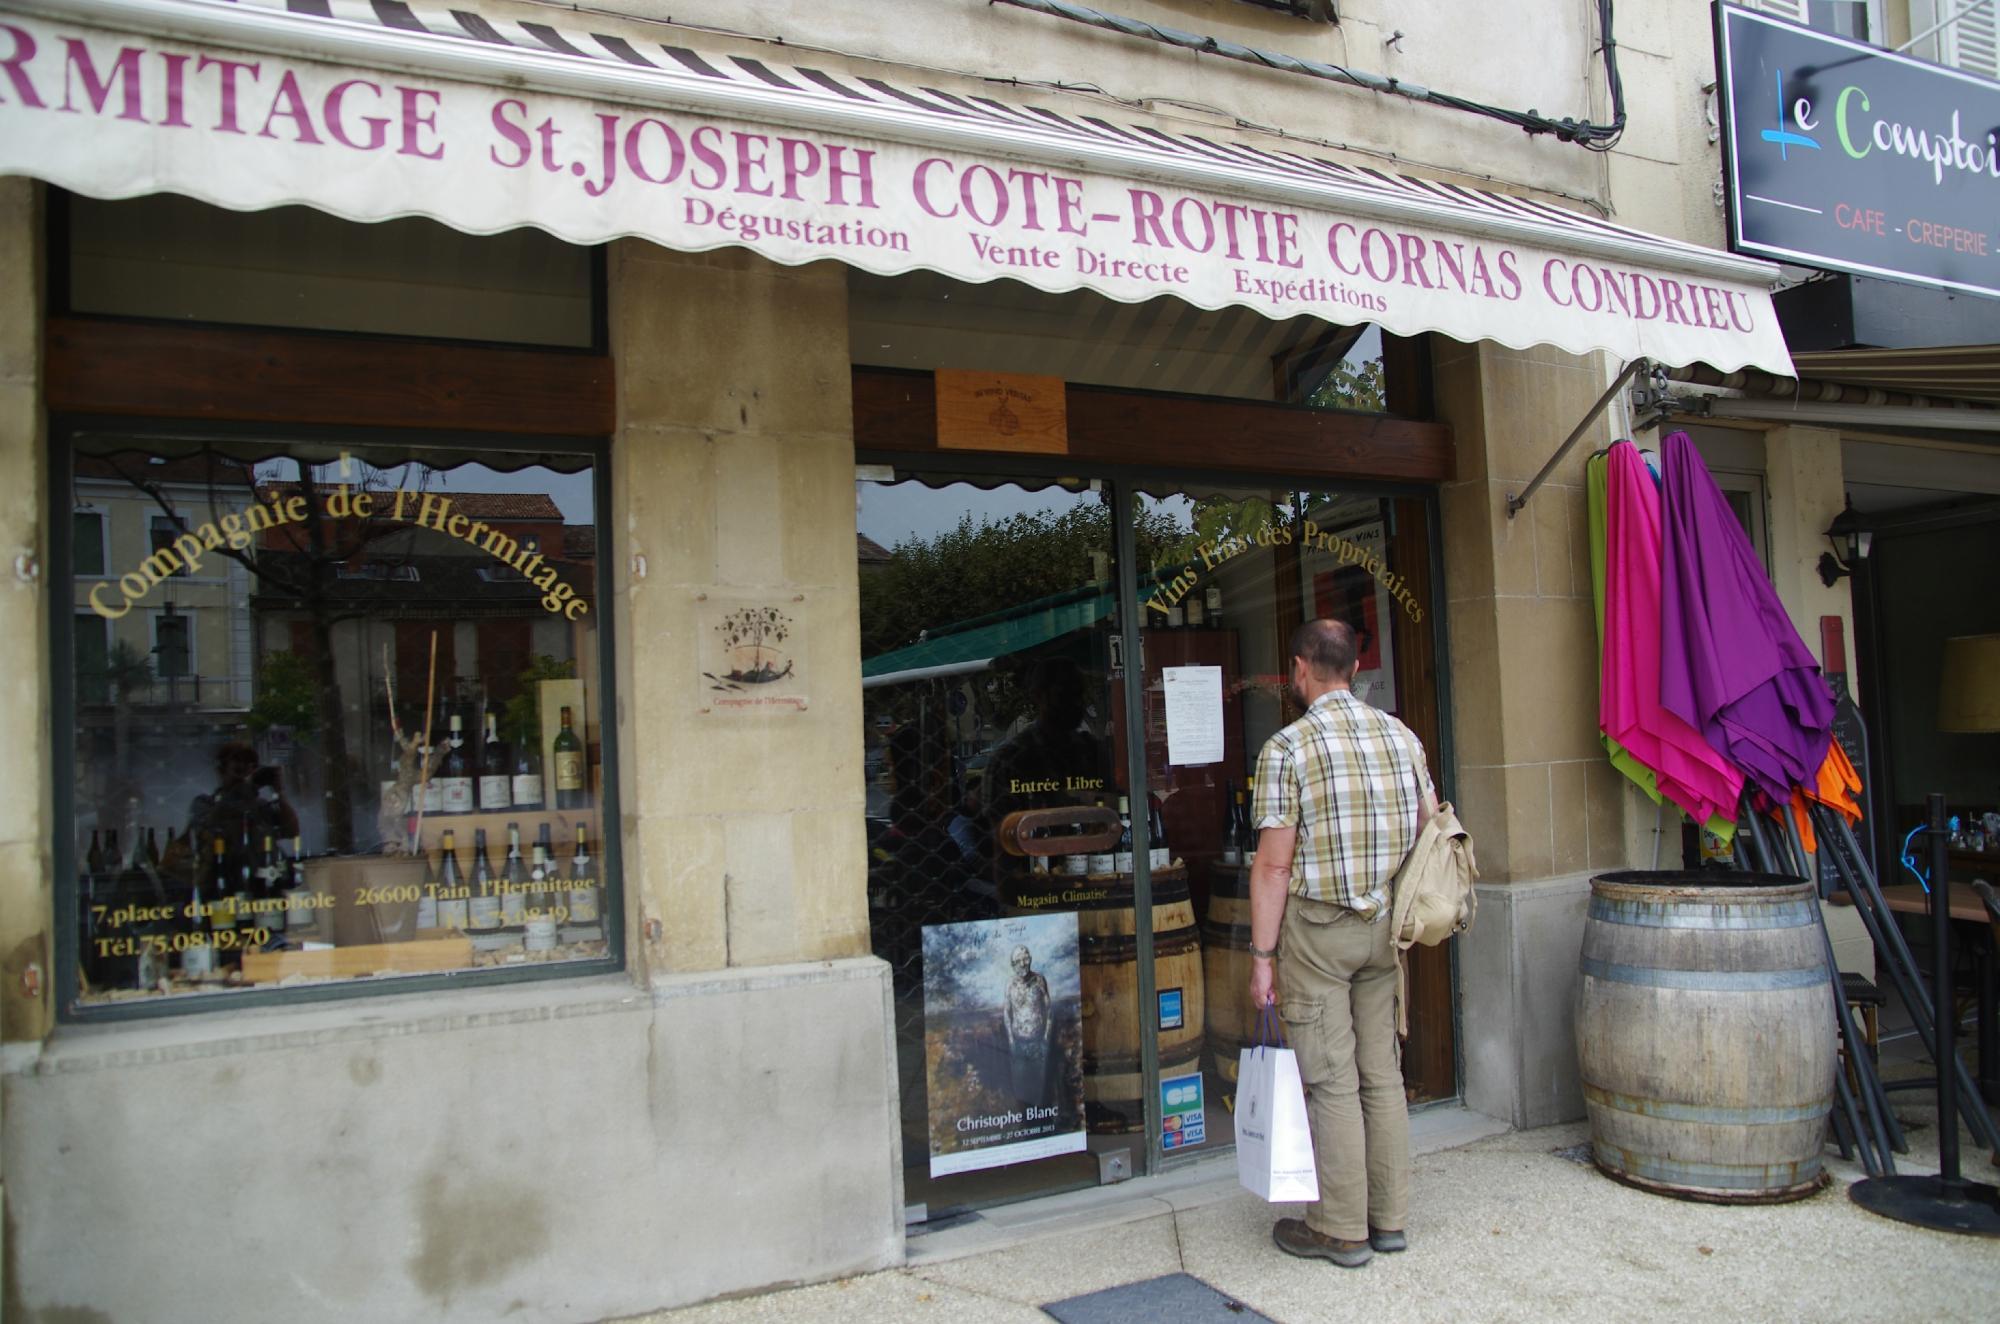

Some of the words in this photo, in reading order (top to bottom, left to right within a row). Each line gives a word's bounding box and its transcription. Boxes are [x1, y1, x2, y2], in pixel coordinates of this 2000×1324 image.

[1761, 69, 1821, 162] Le
[1835, 203, 1886, 238] CAFE
[1907, 219, 1988, 256] CREPERIE
[684, 197, 911, 252] Dégustation
[969, 233, 1061, 269] Vente
[1077, 246, 1189, 284] Directe
[1233, 268, 1388, 313] Expéditions
[1327, 222, 1522, 301] CORNAS
[1543, 258, 1755, 333] CONDRIEU
[88, 490, 308, 620] Compagnie
[327, 484, 373, 518] de
[391, 488, 588, 621] l'Hermitage
[1146, 566, 1198, 615] Vins
[1197, 534, 1248, 571] Fins
[1256, 524, 1292, 547] des
[1303, 520, 1425, 625] Propriétaires
[1010, 778, 1060, 794] Entrée
[1066, 776, 1104, 790] Libre
[183, 900, 213, 918] du
[221, 891, 336, 914] Taurobole
[354, 884, 420, 905] 26600
[424, 882, 471, 900] Tain
[1017, 892, 1059, 909] Magasin
[957, 1110, 1023, 1132] Christophe
[1026, 1105, 1059, 1121] Blanc
[1185, 1112, 1202, 1122] VISA
[1186, 1128, 1203, 1138] VISA
